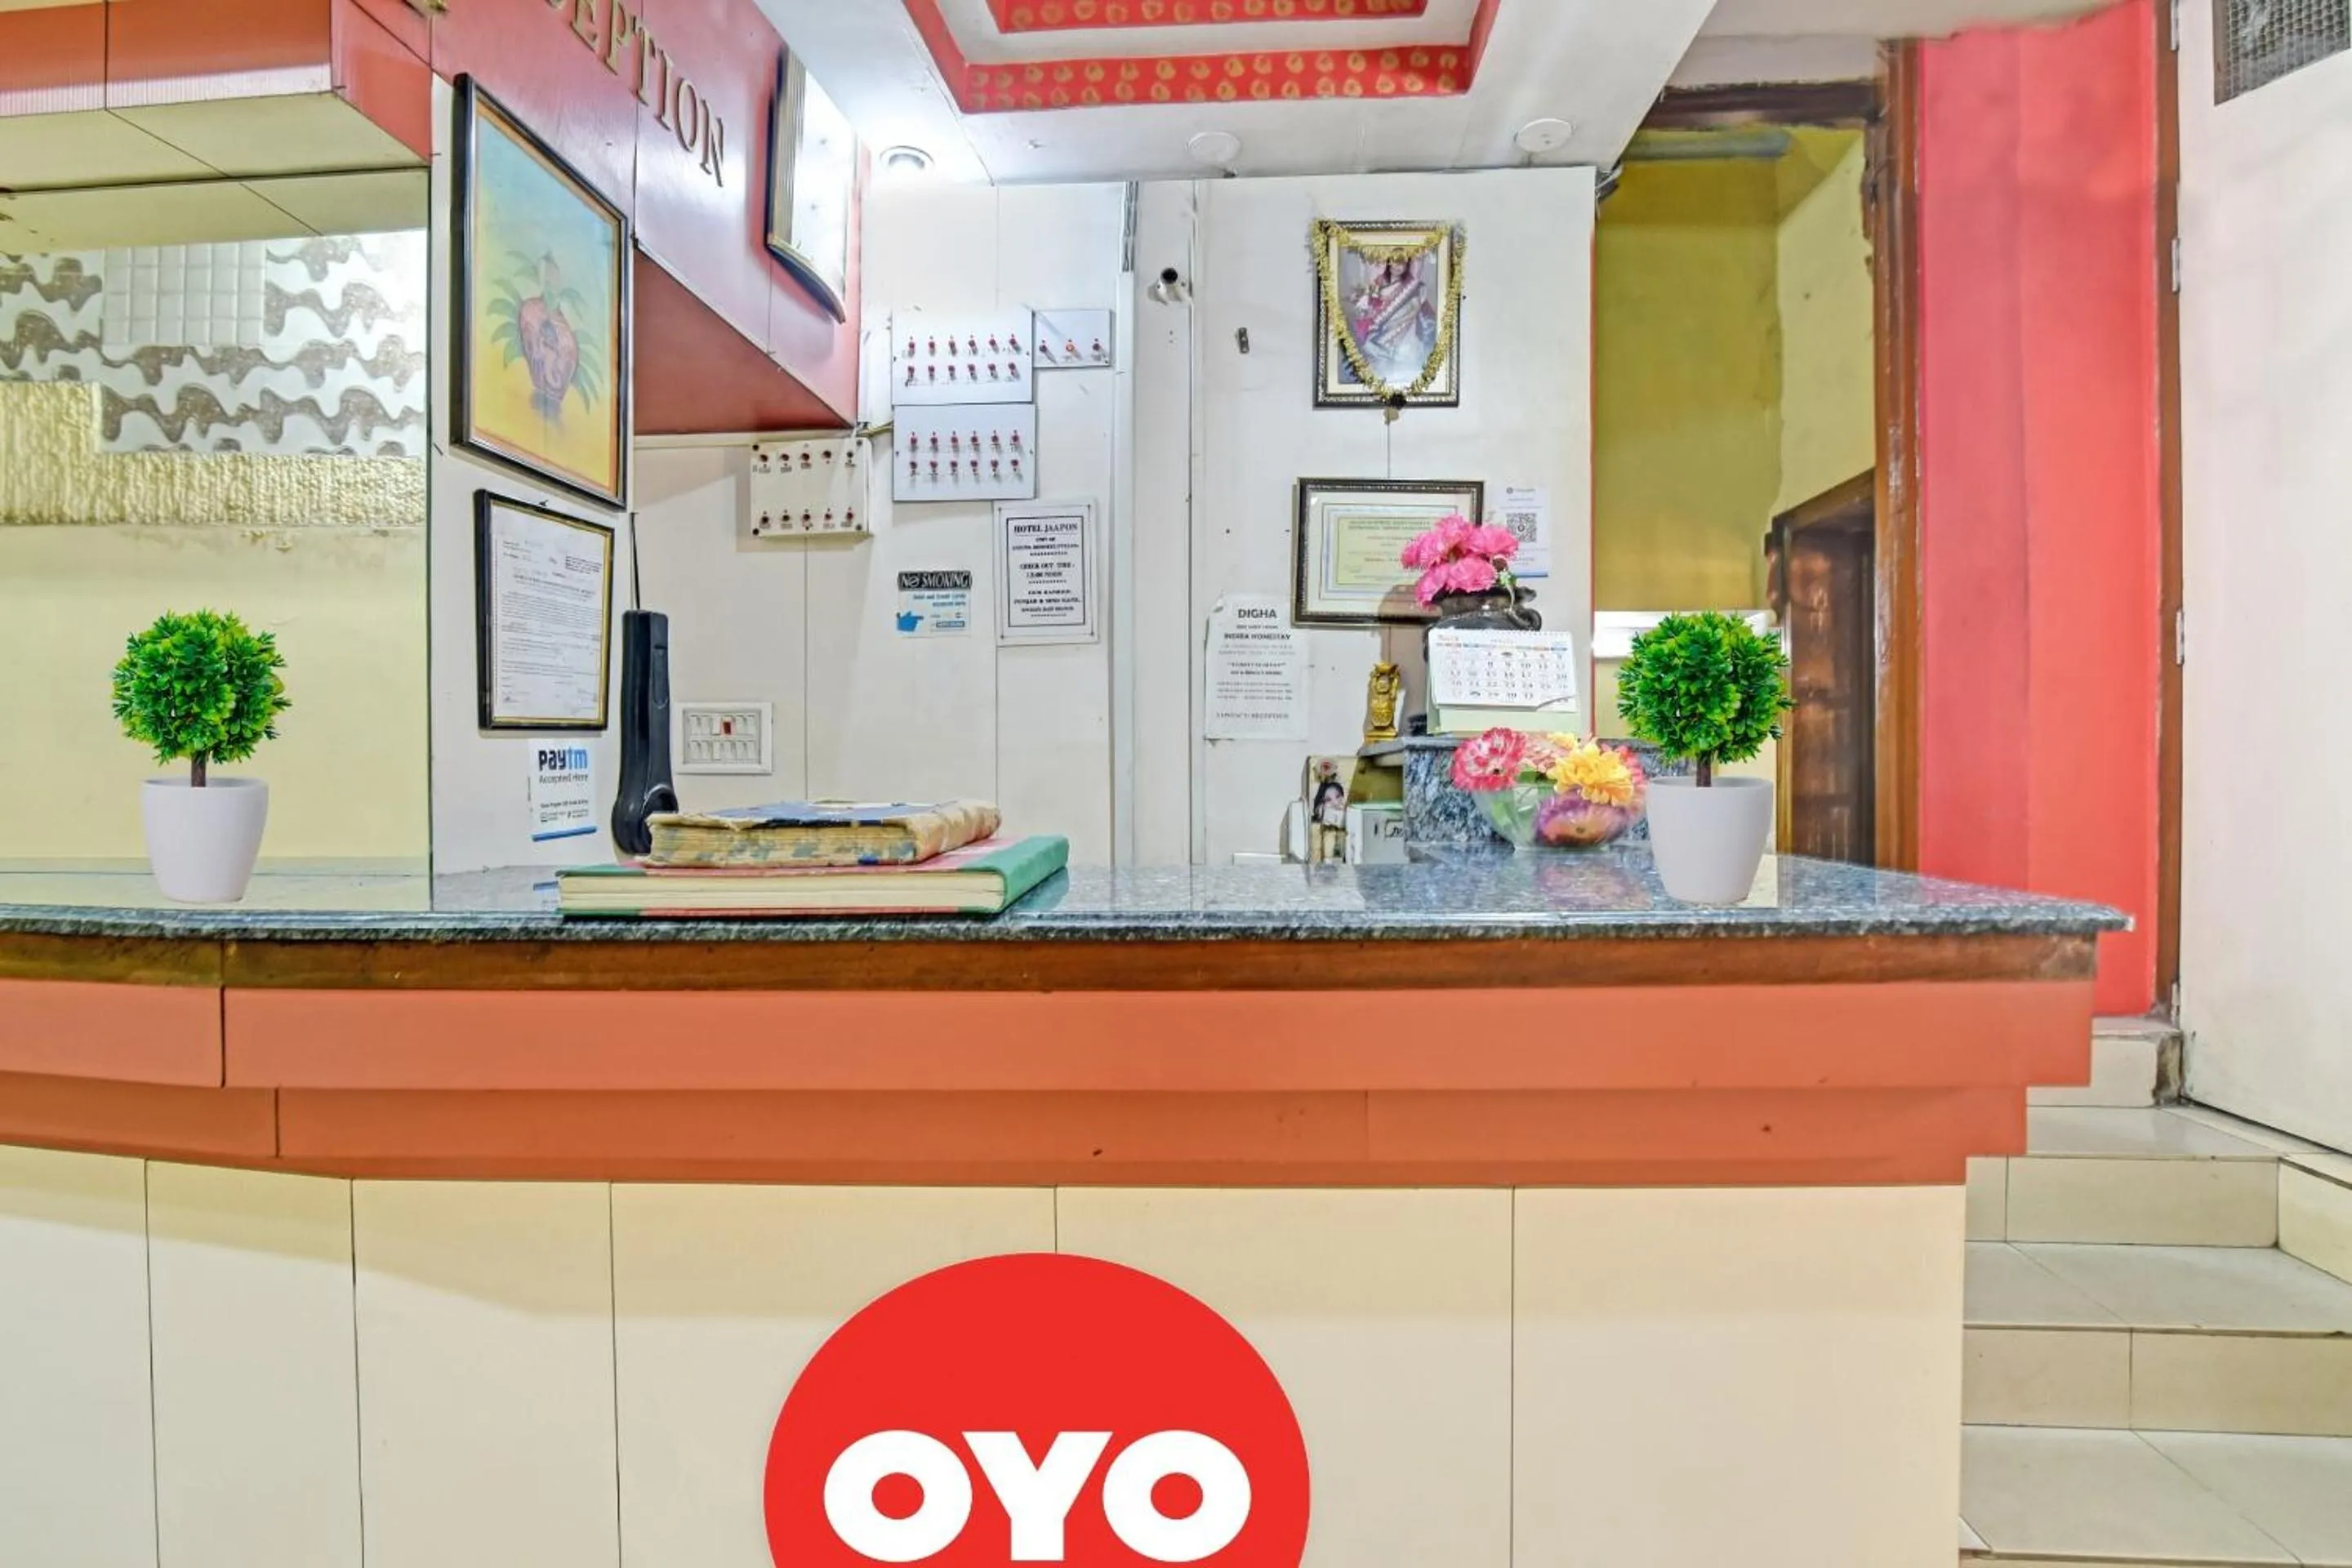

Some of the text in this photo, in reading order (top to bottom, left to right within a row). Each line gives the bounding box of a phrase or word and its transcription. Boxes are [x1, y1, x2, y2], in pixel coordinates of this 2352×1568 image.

[545, 0, 724, 188] EPTION
[1013, 524, 1042, 533] HOTEL
[902, 572, 969, 587] NO SMOKING
[1238, 608, 1277, 618] DIGHA
[540, 773, 572, 784] Accepted
